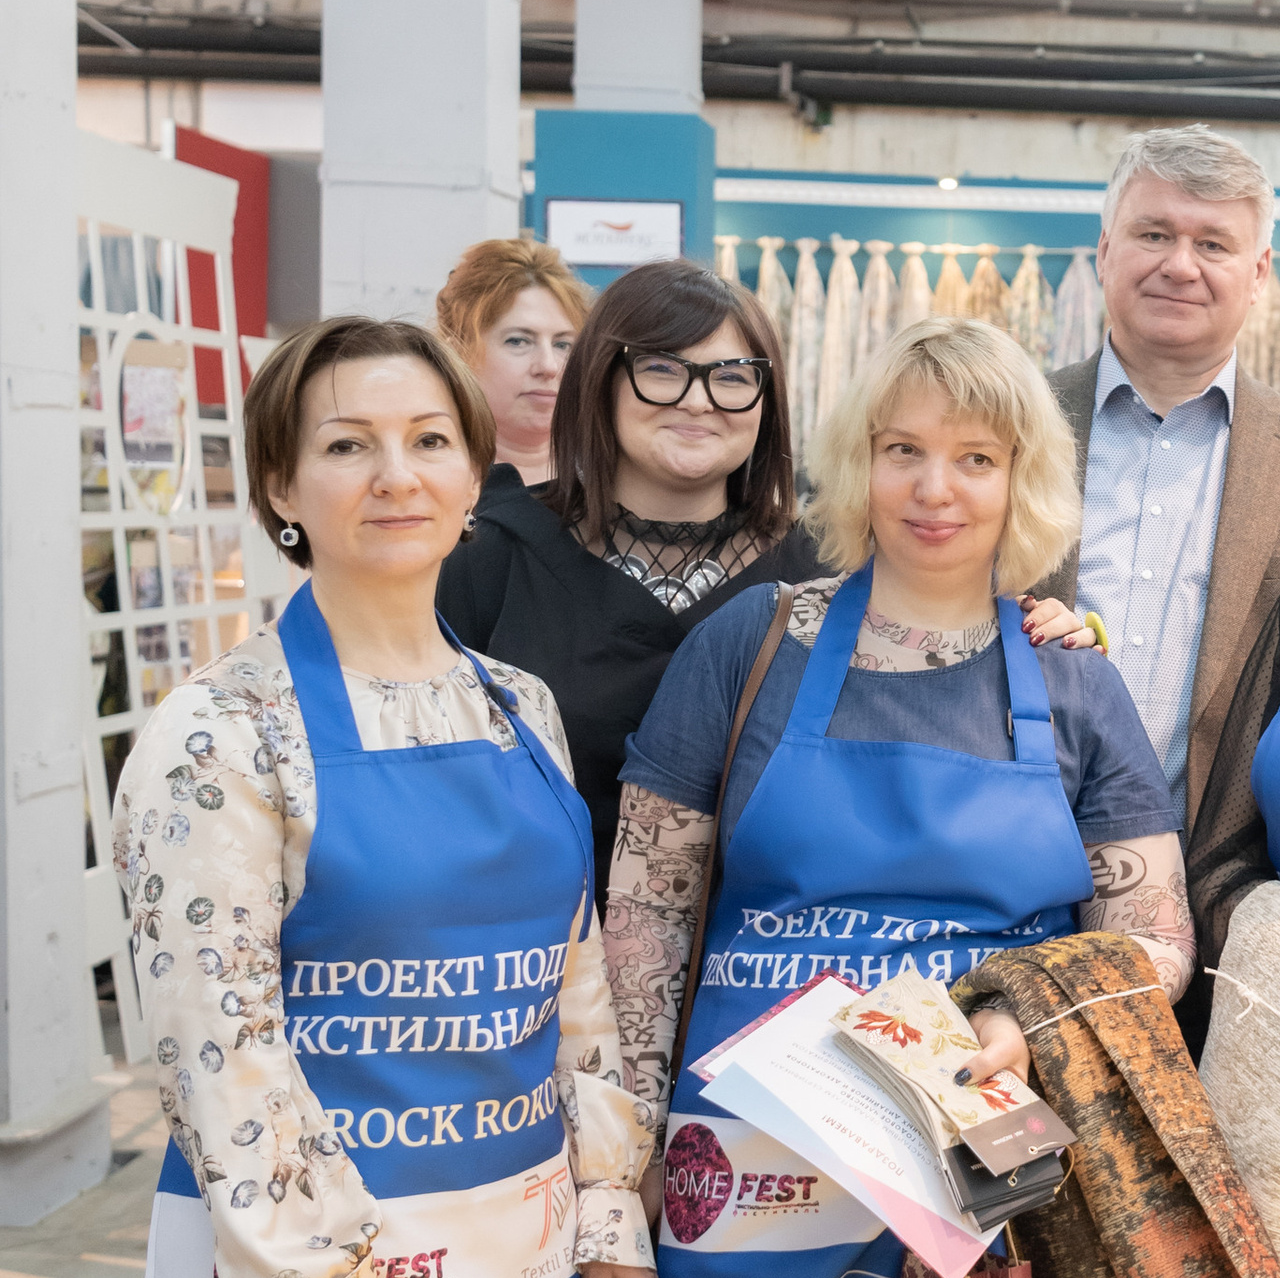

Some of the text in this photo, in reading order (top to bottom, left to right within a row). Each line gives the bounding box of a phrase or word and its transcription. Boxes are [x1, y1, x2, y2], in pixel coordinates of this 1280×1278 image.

[288, 955, 484, 998] ПРОЕКТ
[285, 998, 553, 1056] КСТИЛЬНАЯ
[324, 1103, 464, 1150] ROCK
[820, 1112, 905, 1178] ПОЗДРАВЛЯЕМ!
[879, 1113, 917, 1142] ГОДОВОЕ
[665, 1165, 819, 1203] HOME FEST
